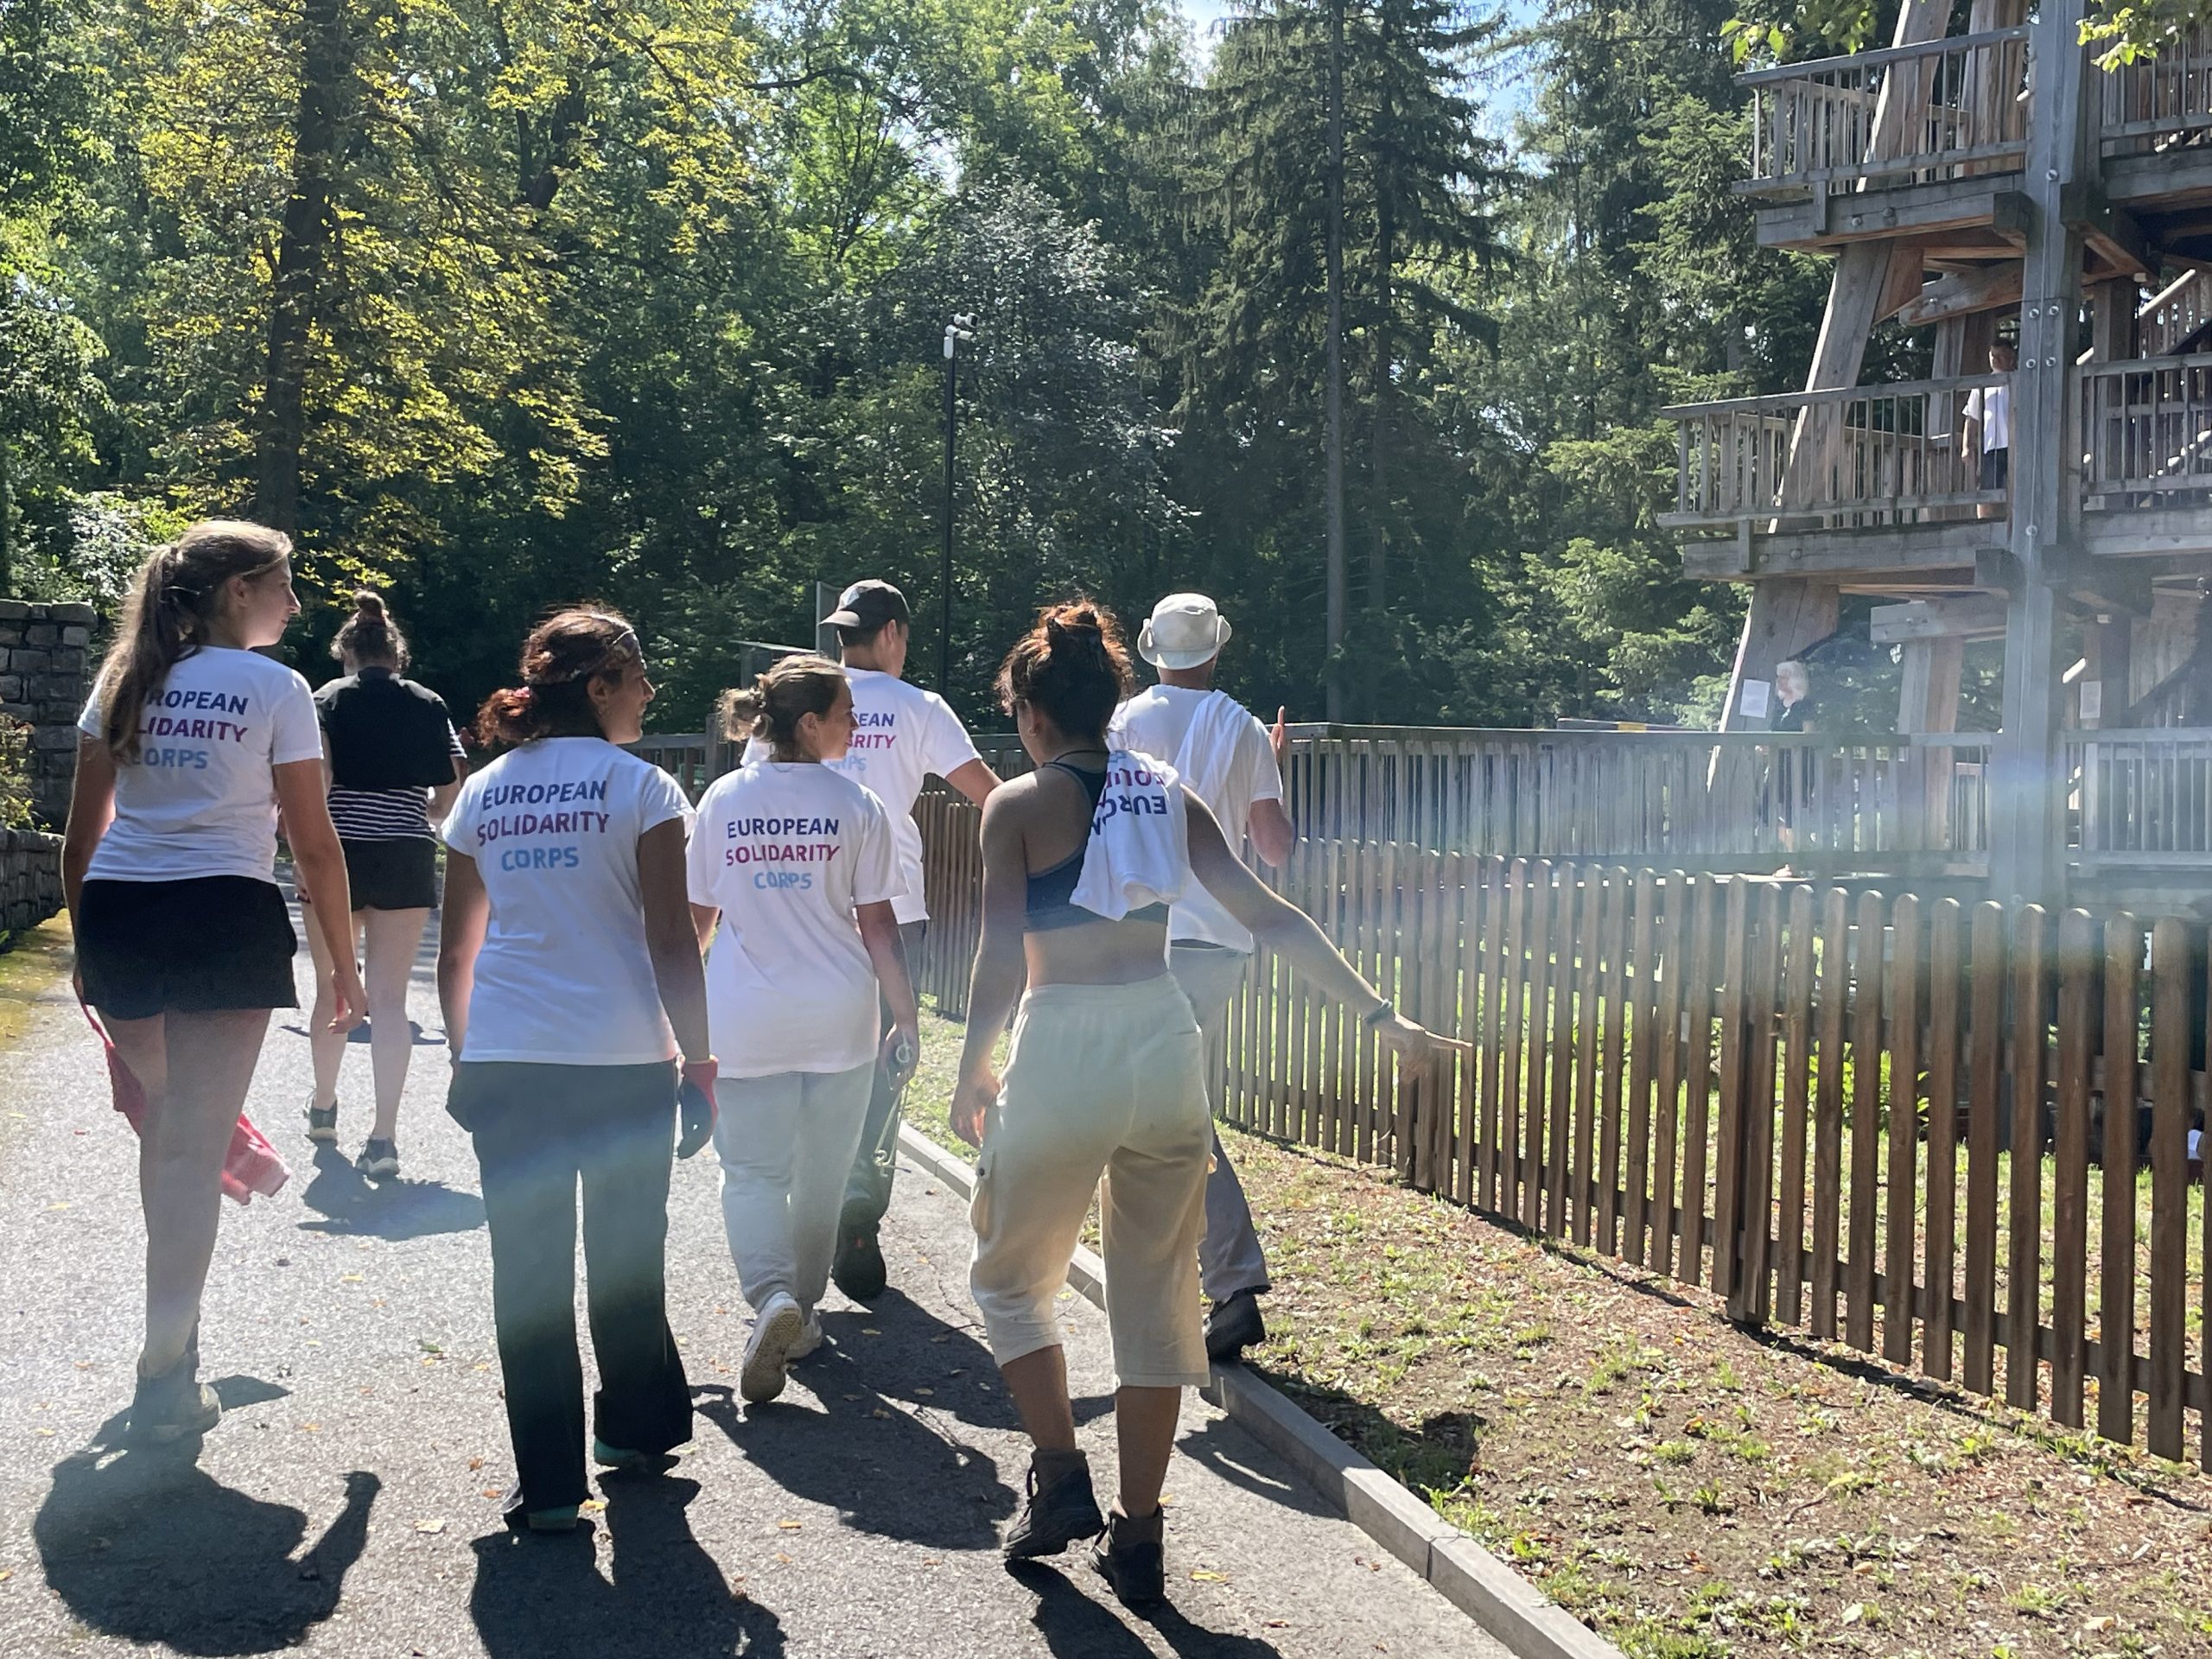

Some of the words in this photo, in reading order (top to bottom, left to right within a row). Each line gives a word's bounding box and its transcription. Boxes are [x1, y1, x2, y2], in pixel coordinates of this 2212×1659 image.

[146, 689, 249, 715] ROPEAN
[136, 716, 248, 743] IDARITY
[481, 779, 607, 812] EUROPEAN
[477, 810, 610, 847] SOLIDARITY
[727, 817, 839, 839] EUROPEAN
[500, 846, 580, 872] CORPS
[726, 843, 841, 867] SOLIDARITY
[753, 872, 813, 890] CORPS
